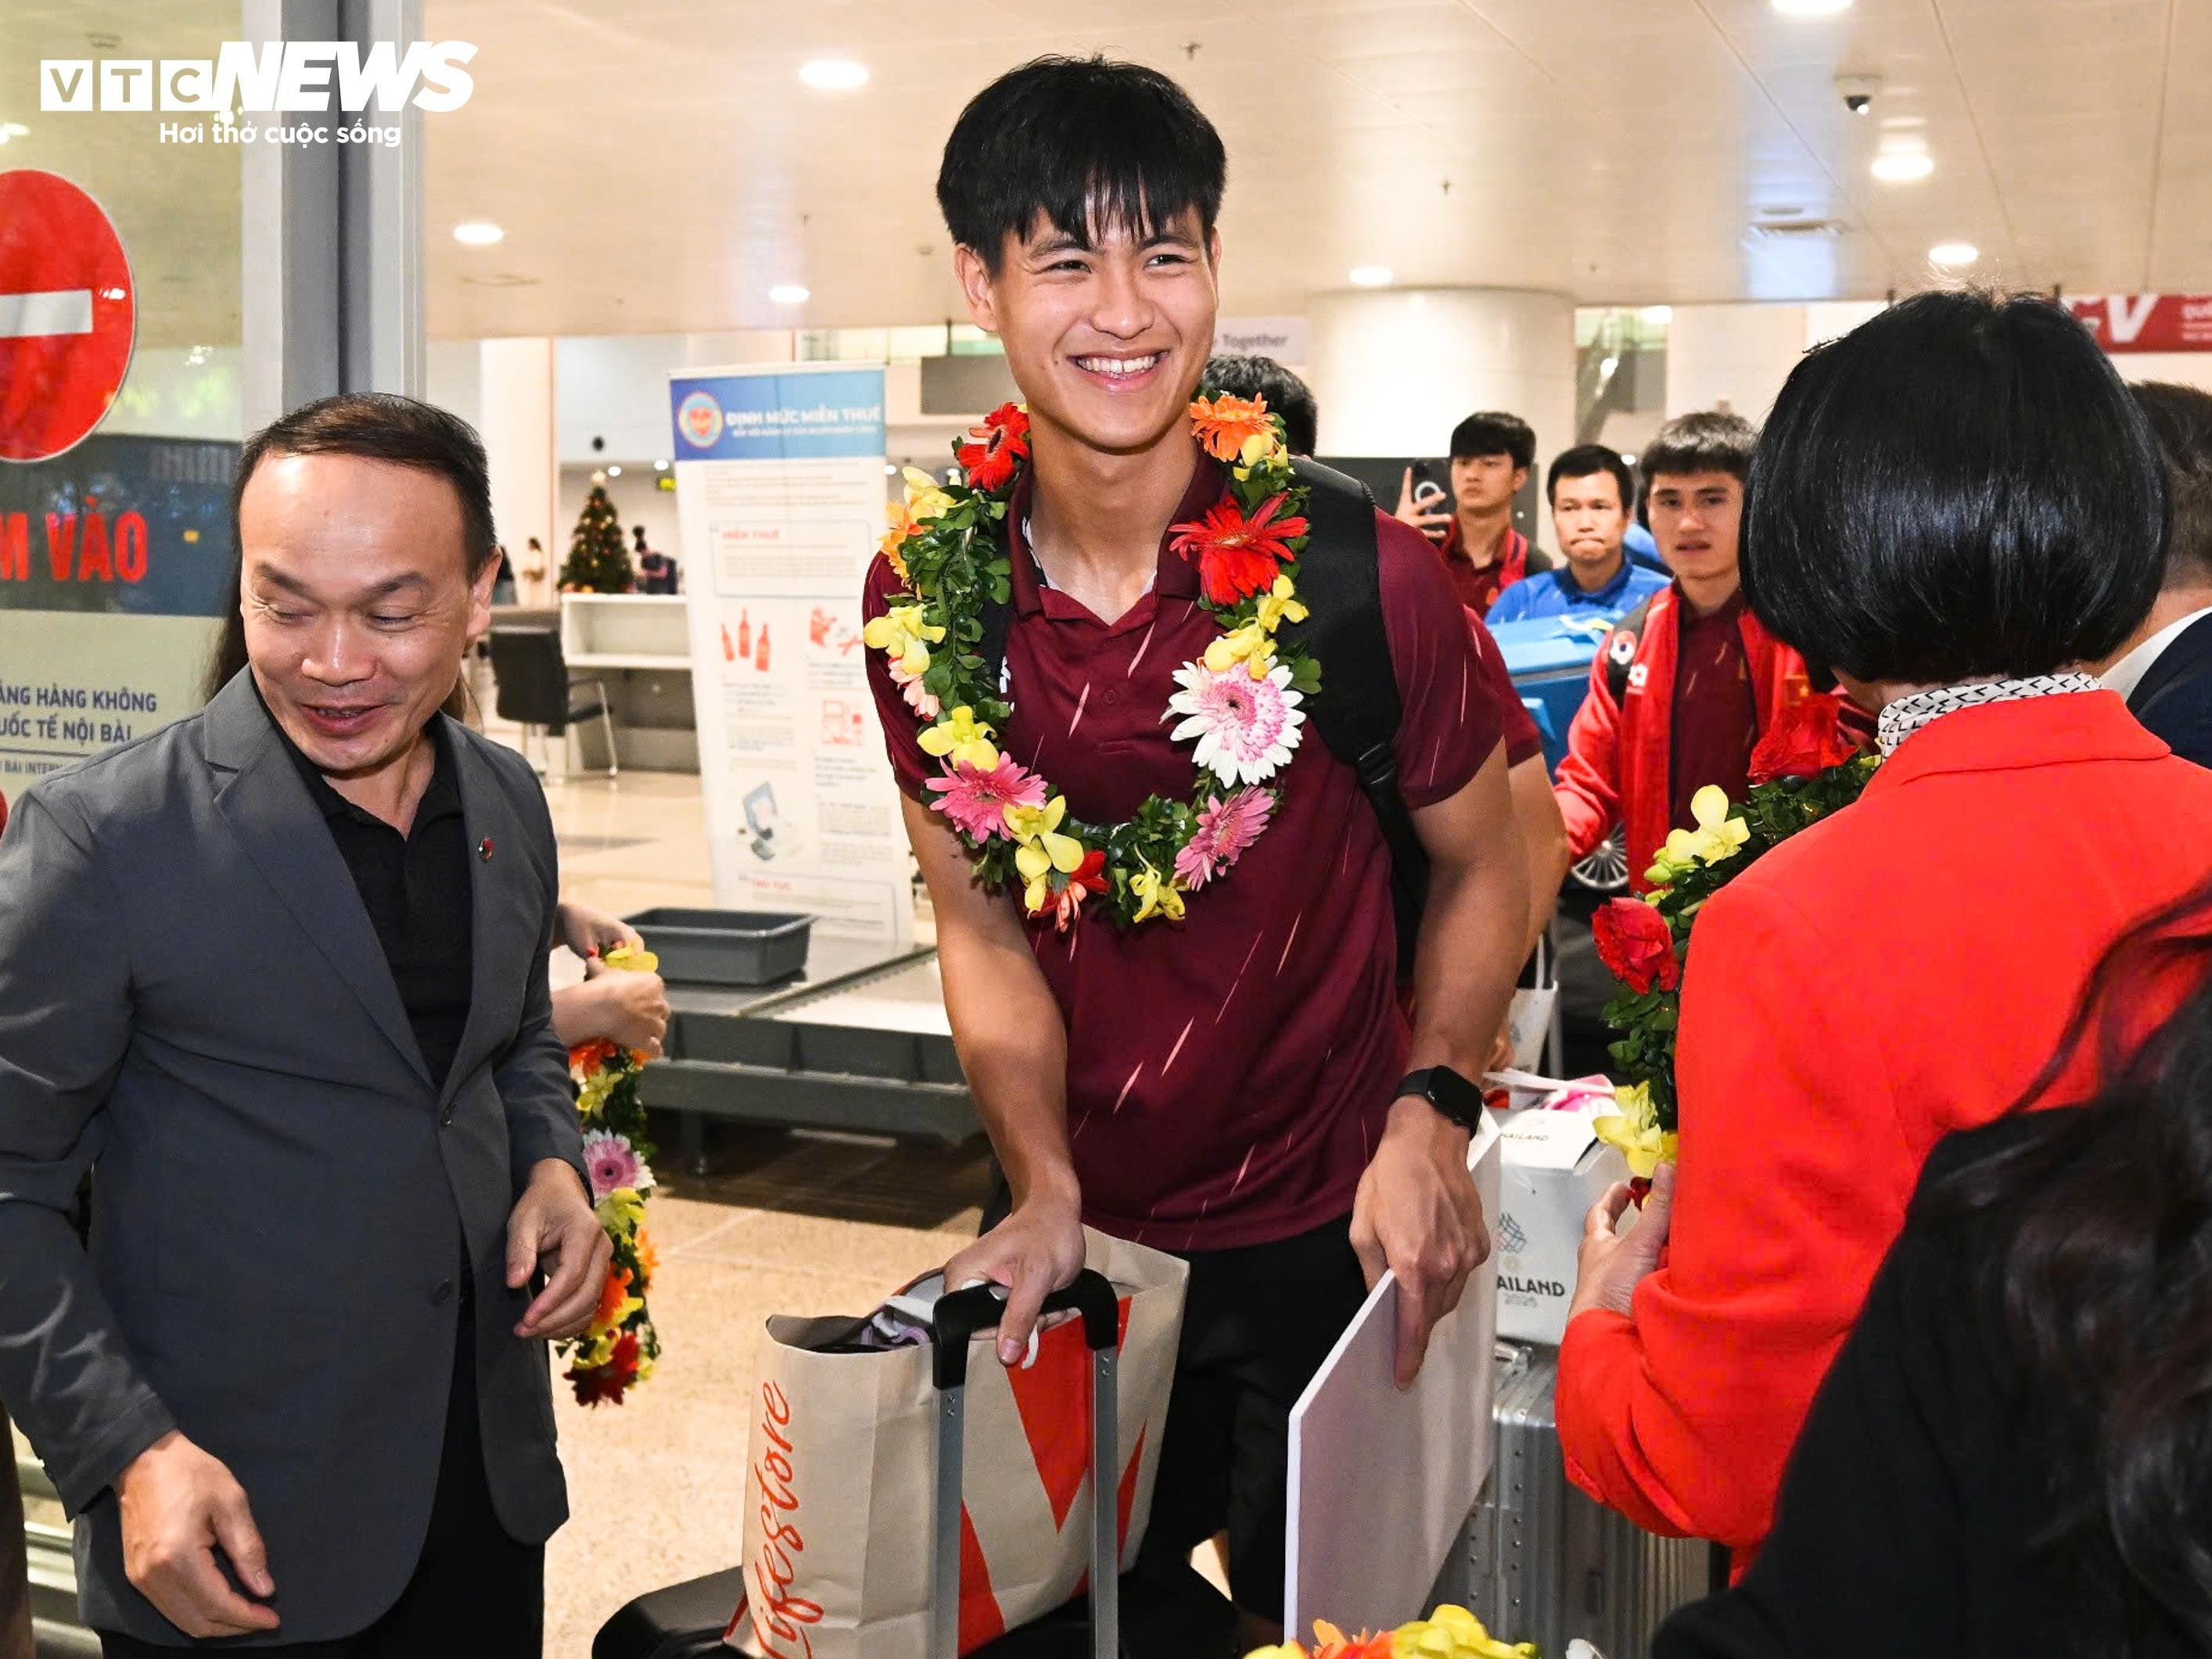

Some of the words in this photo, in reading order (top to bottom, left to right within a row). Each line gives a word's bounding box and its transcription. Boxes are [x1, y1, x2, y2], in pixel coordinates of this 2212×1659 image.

[45, 494, 149, 584] VÀO
[37, 682, 86, 709] HÀNG
[92, 685, 157, 713] KHÔNG
[37, 712, 57, 740] TẾ
[63, 716, 94, 747] NỘI
[101, 718, 131, 743] BÀI
